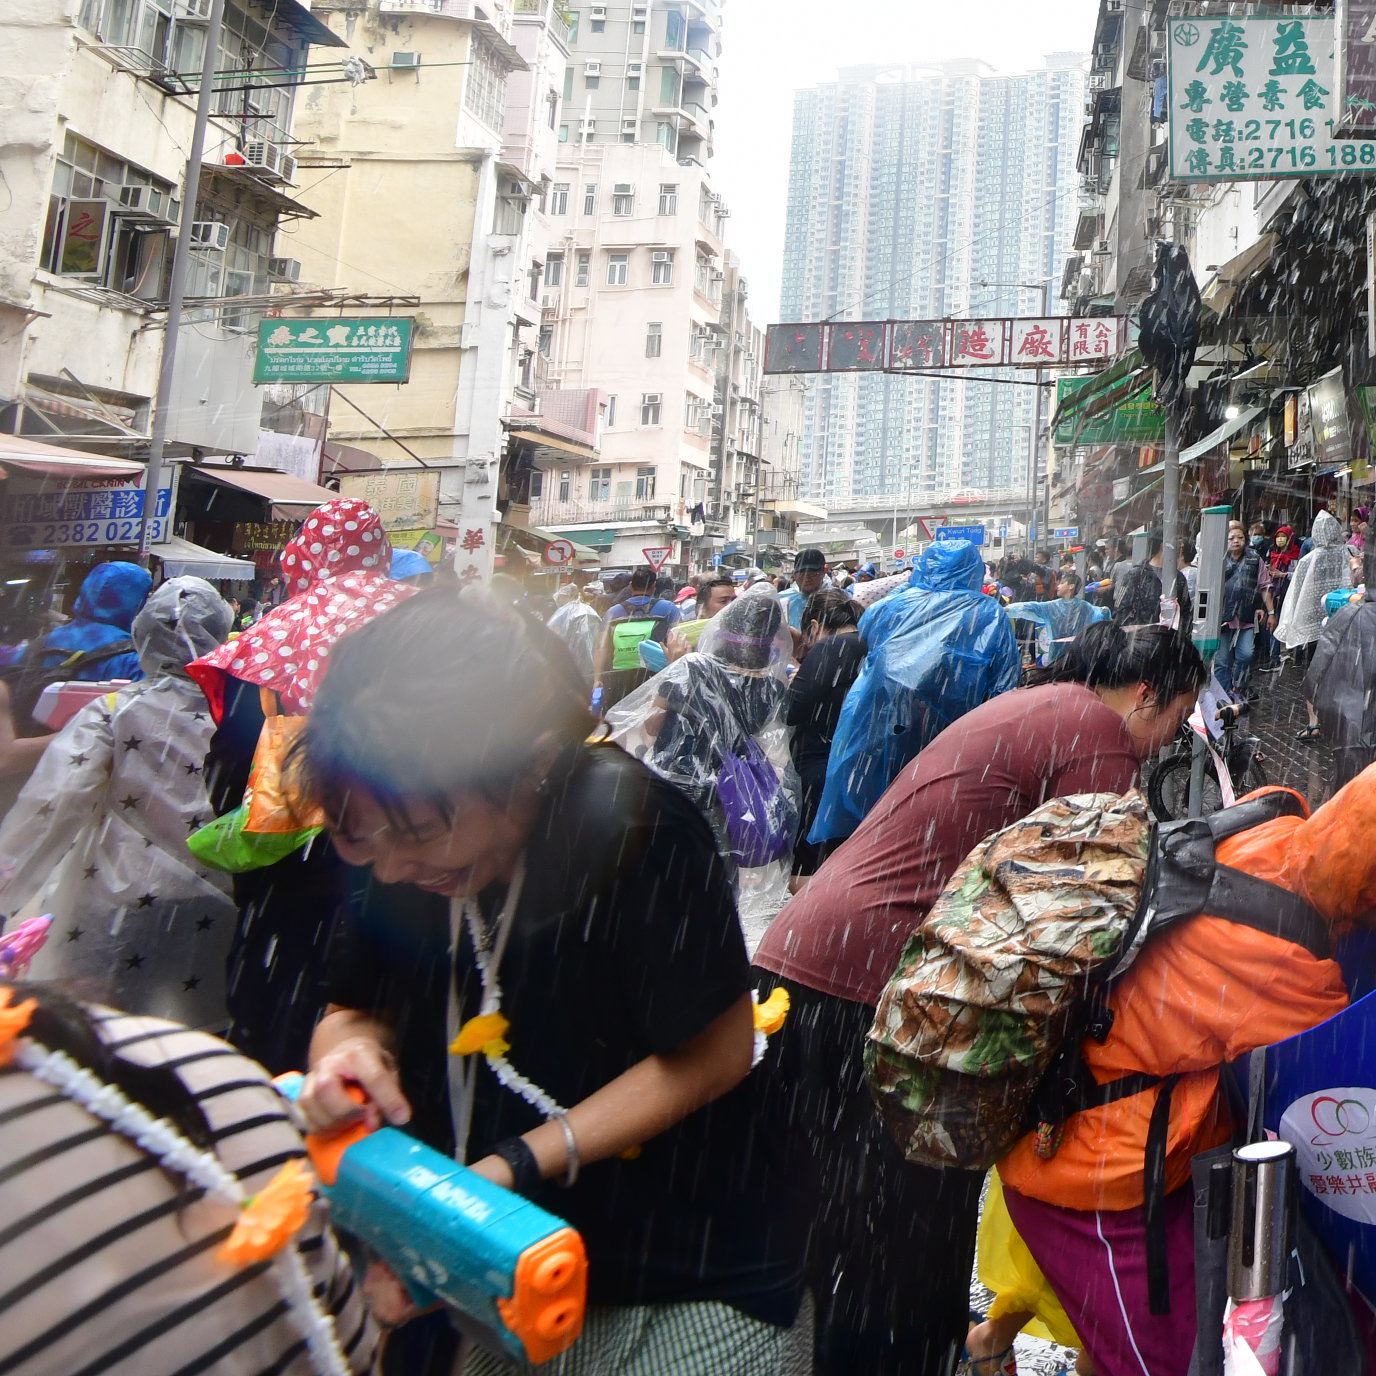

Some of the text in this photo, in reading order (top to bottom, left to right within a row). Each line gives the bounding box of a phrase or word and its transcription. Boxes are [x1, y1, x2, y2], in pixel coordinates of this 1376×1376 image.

[1195, 20, 1335, 78] 廣益
[1179, 78, 1330, 113] 專營素食
[43, 521, 99, 543] 2382
